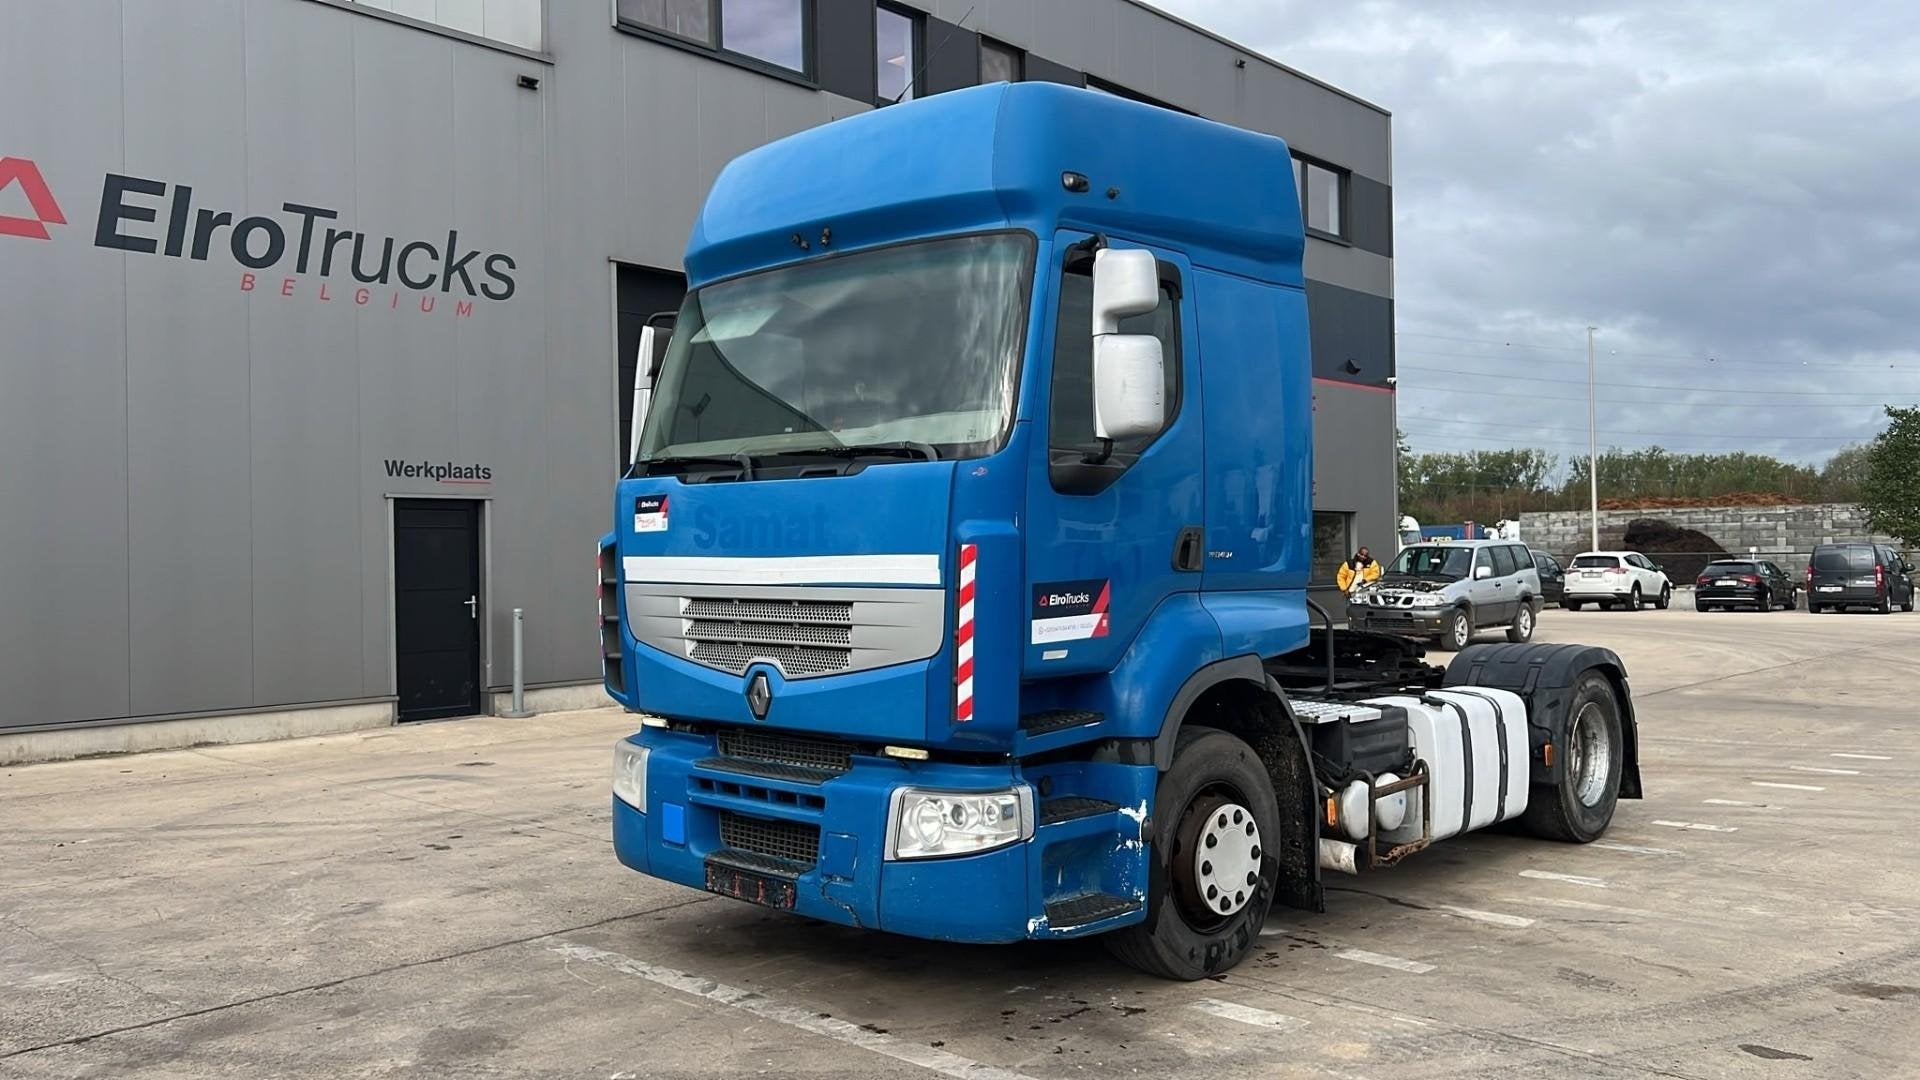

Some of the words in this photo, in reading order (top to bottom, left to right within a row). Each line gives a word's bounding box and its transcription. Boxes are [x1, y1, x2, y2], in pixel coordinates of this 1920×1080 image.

[94, 173, 517, 301] ElroTrucks
[241, 273, 474, 317] BELGIUM
[384, 460, 491, 481] Werkplaats
[1049, 592, 1089, 606] ElroTrucks
